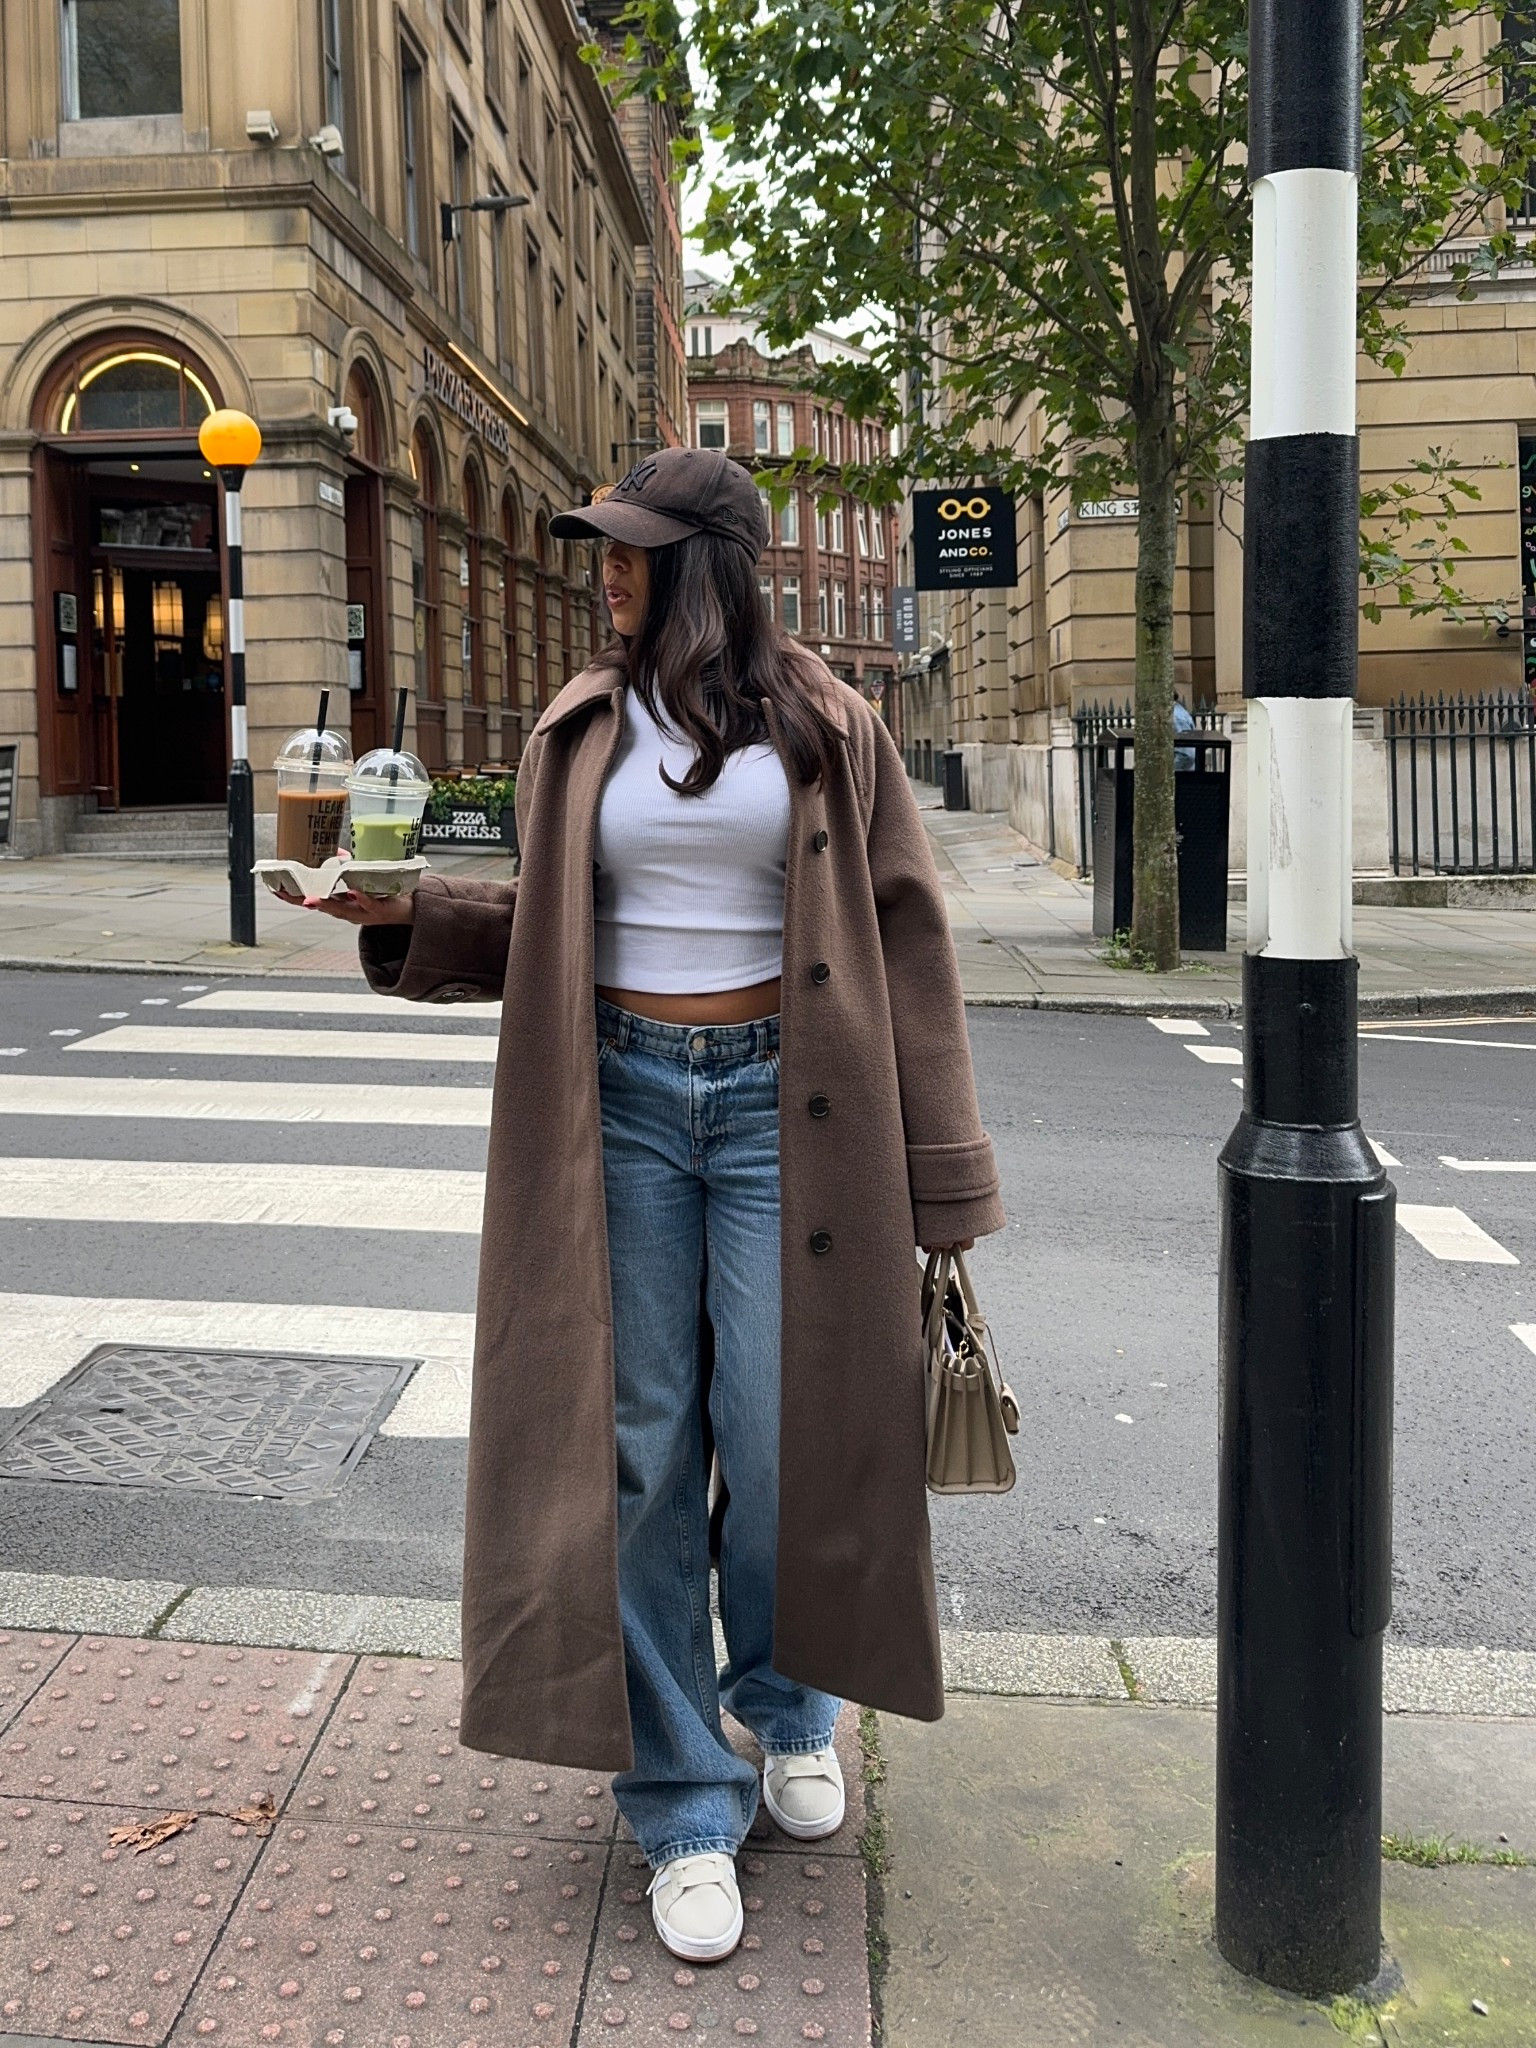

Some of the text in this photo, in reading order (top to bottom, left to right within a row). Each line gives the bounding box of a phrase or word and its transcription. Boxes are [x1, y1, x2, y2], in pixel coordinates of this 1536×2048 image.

[1081, 503, 1117, 516] KING
[938, 527, 992, 541] JONES
[903, 597, 914, 641] HUDSON
[318, 800, 345, 814] LEAVE
[308, 815, 327, 829] THE
[452, 812, 487, 825] ZZA
[422, 824, 502, 839] EXPRESS
[403, 832, 416, 846] THE
